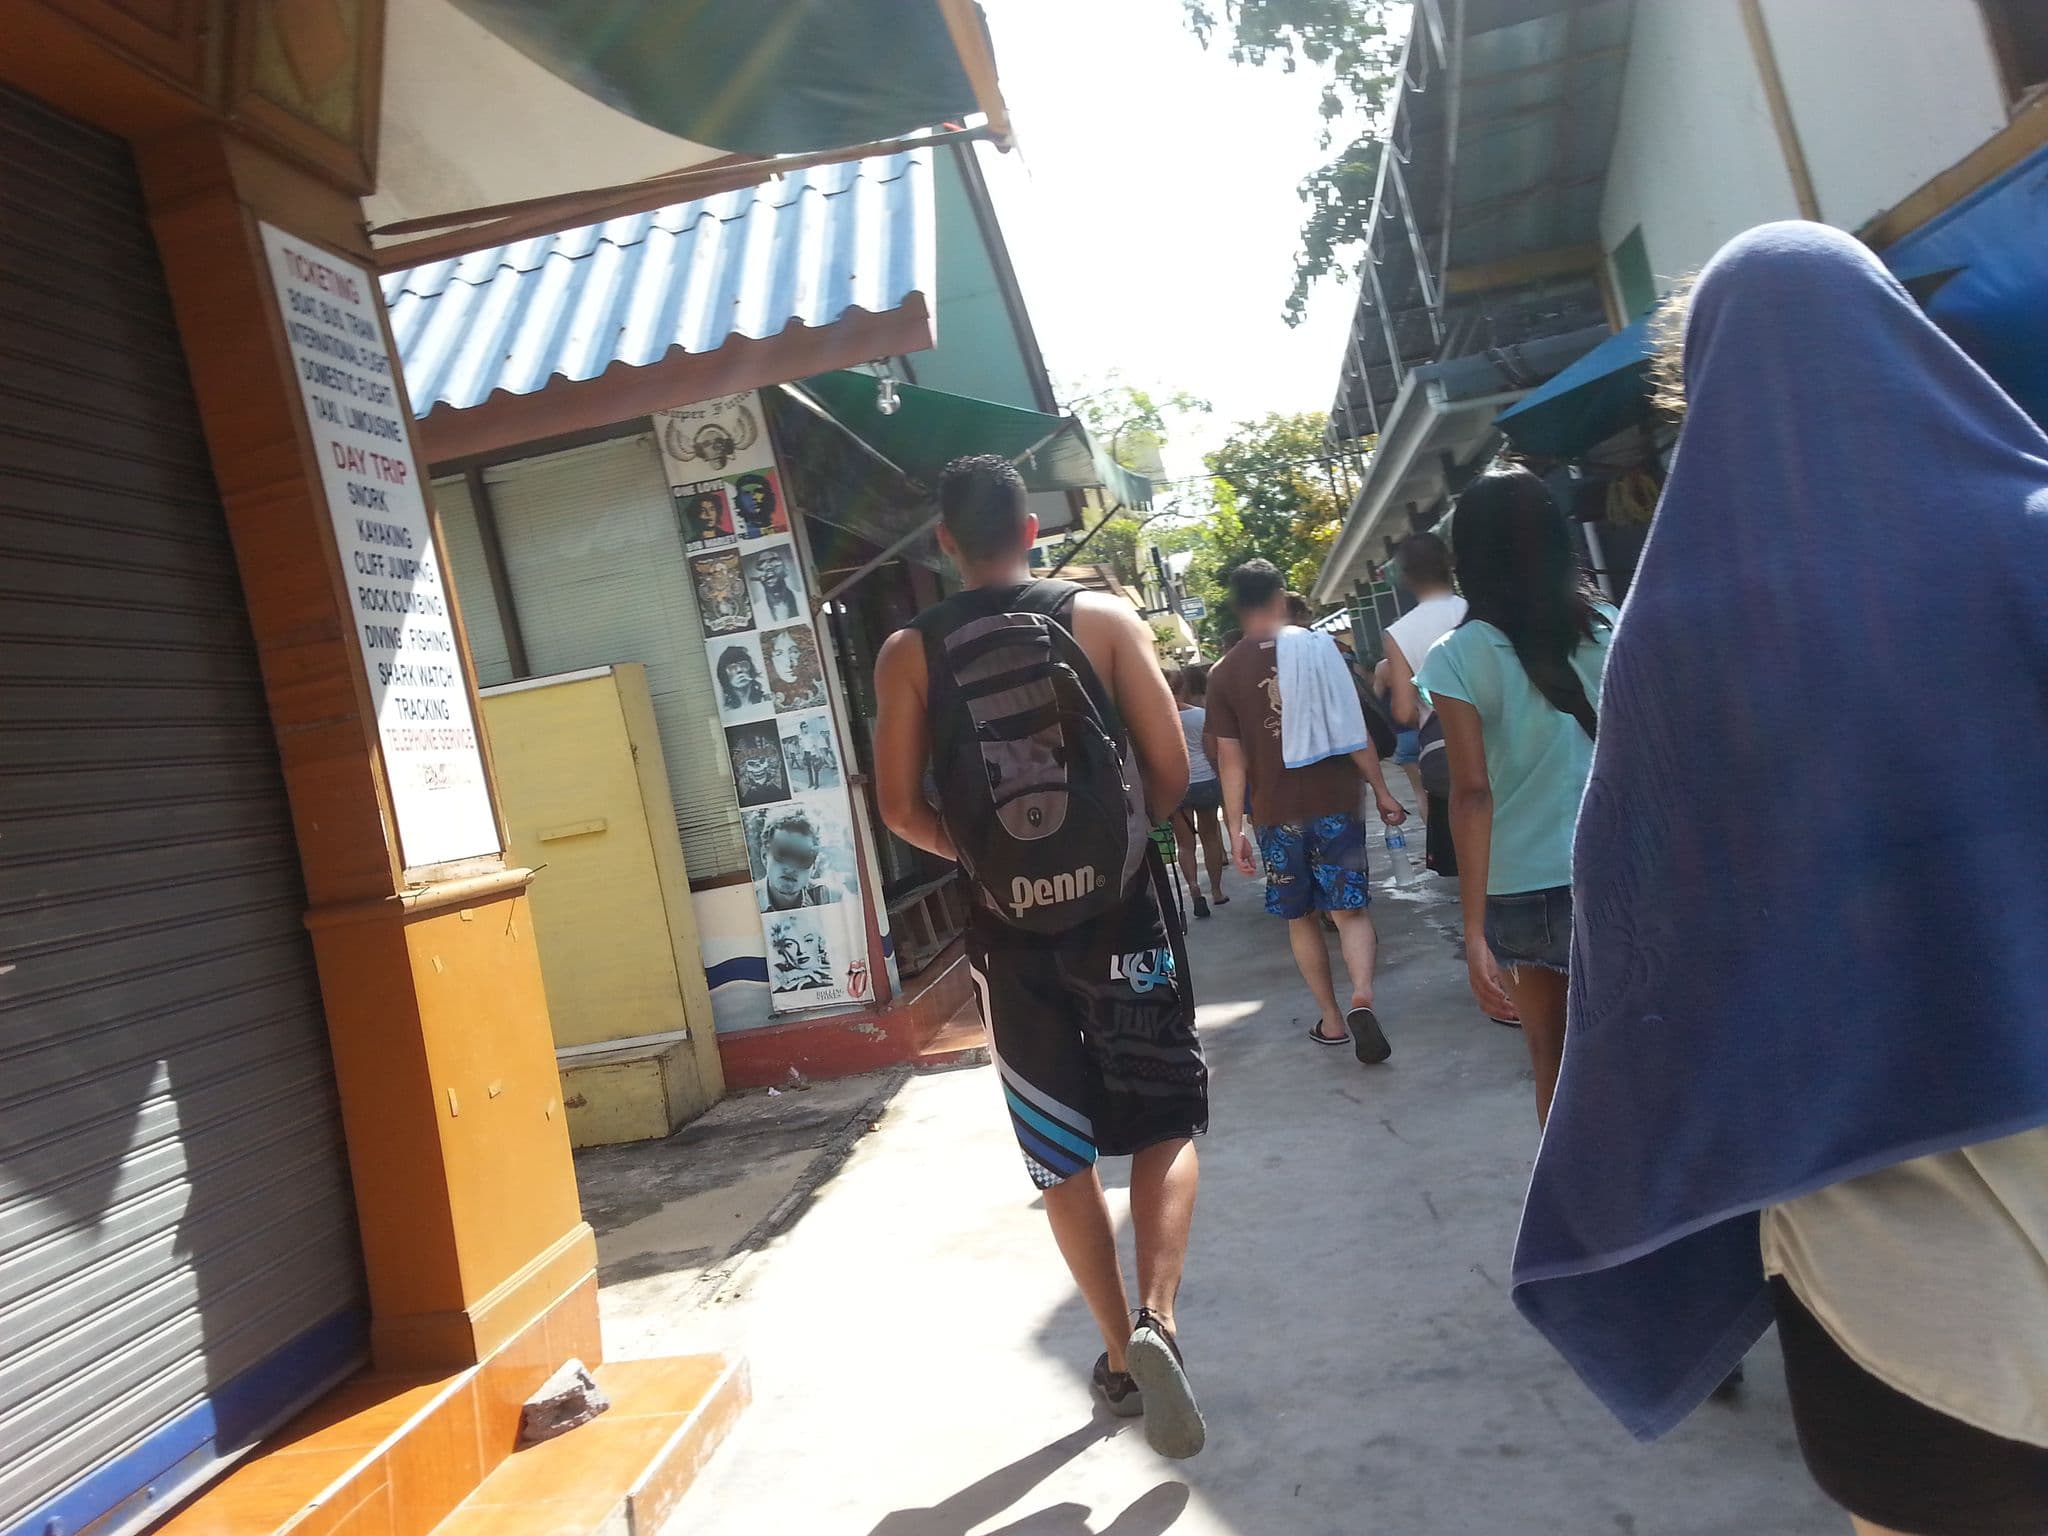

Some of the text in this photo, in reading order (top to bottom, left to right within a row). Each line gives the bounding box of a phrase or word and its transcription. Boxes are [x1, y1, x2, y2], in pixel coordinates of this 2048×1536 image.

[283, 248, 360, 305] TICKETING
[302, 357, 393, 406] DOMESTIC FLIGHT
[346, 406, 401, 442] LIMOUSINE
[332, 442, 408, 485] DAY TRIP
[348, 482, 388, 511] SNORK
[357, 519, 412, 547] KAYAKING
[354, 551, 433, 581] CLIFF JUMPING
[359, 587, 442, 615] ROCK CLIMBING
[365, 625, 450, 650] DIVING FISHING
[379, 663, 454, 686] SHARK WATCH
[397, 699, 449, 719] TRACKING
[439, 728, 473, 749] SERVICE
